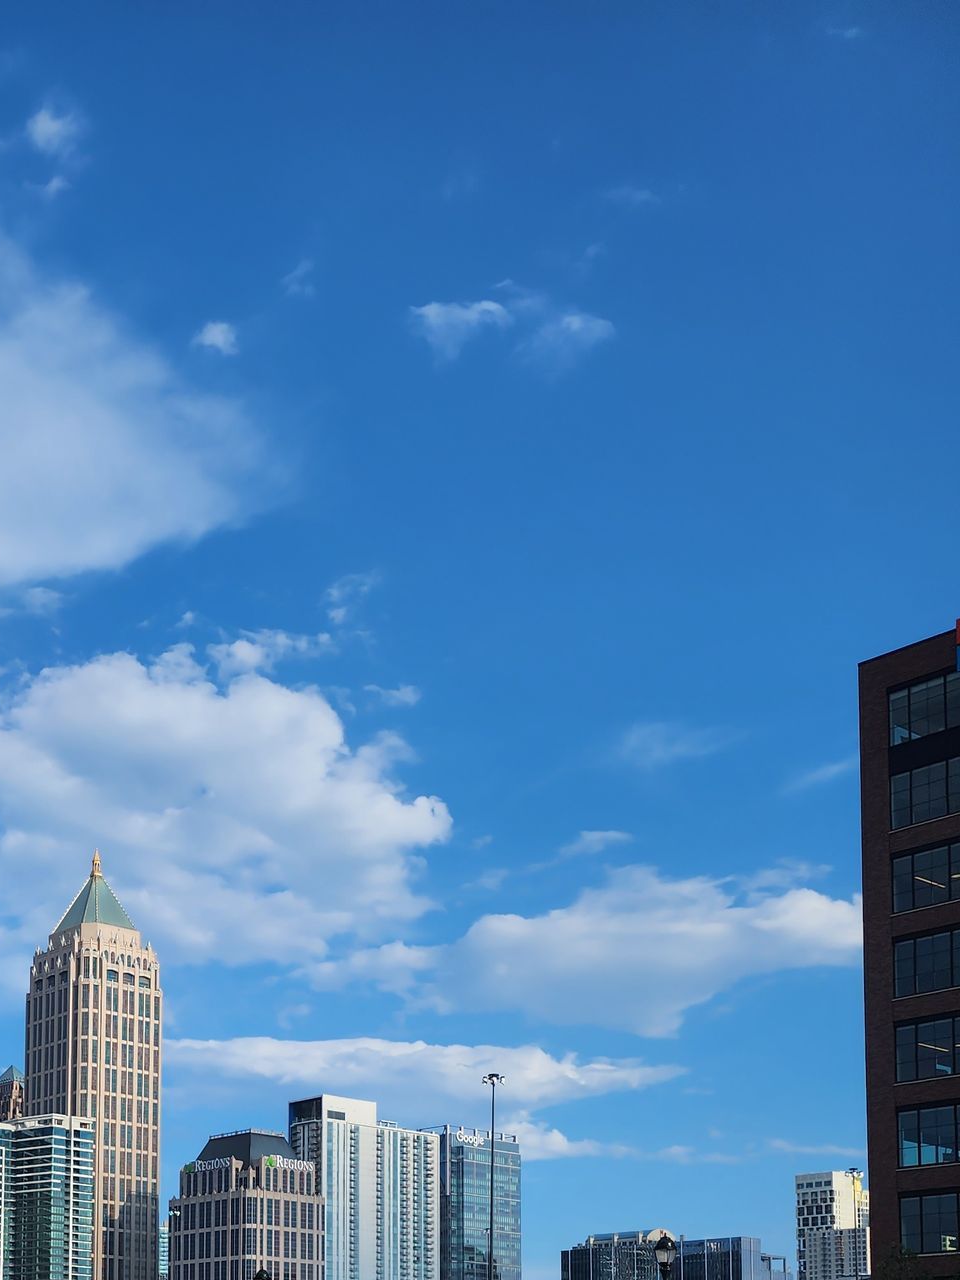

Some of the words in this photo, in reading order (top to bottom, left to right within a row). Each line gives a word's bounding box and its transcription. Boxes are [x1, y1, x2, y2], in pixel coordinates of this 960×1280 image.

[457, 1131, 484, 1147] Google
[195, 1157, 231, 1172] REGIONS
[276, 1155, 314, 1171] REGIONS
